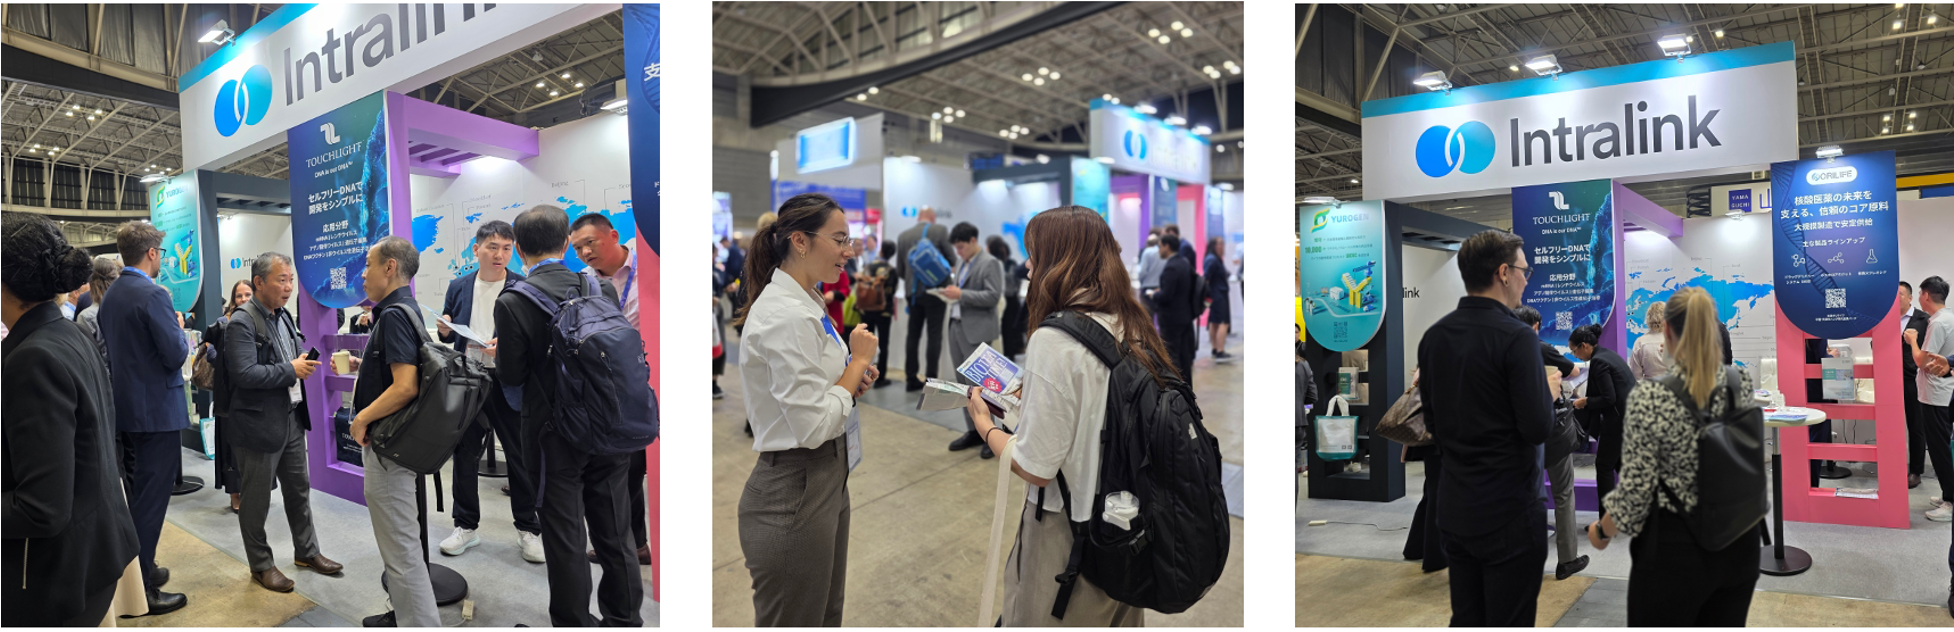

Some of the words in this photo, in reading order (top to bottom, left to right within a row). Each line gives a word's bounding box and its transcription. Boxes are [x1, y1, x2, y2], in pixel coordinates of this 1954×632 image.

[1510, 95, 1722, 167] Intralink
[306, 141, 362, 168] TOUCHLIGHT
[308, 181, 363, 203] セルフリーDNAで
[1794, 190, 1872, 206] 核酸医薬の未来を
[308, 193, 364, 215] 開発をシンプルに
[1780, 201, 1889, 219] 支える、信頼のコア原料
[1331, 213, 1369, 223] YUROGEN
[1533, 213, 1591, 225] TOUCHLIGHT
[1534, 243, 1591, 255] セルフリーDNAで
[1534, 253, 1592, 265] 開発をシンプルに
